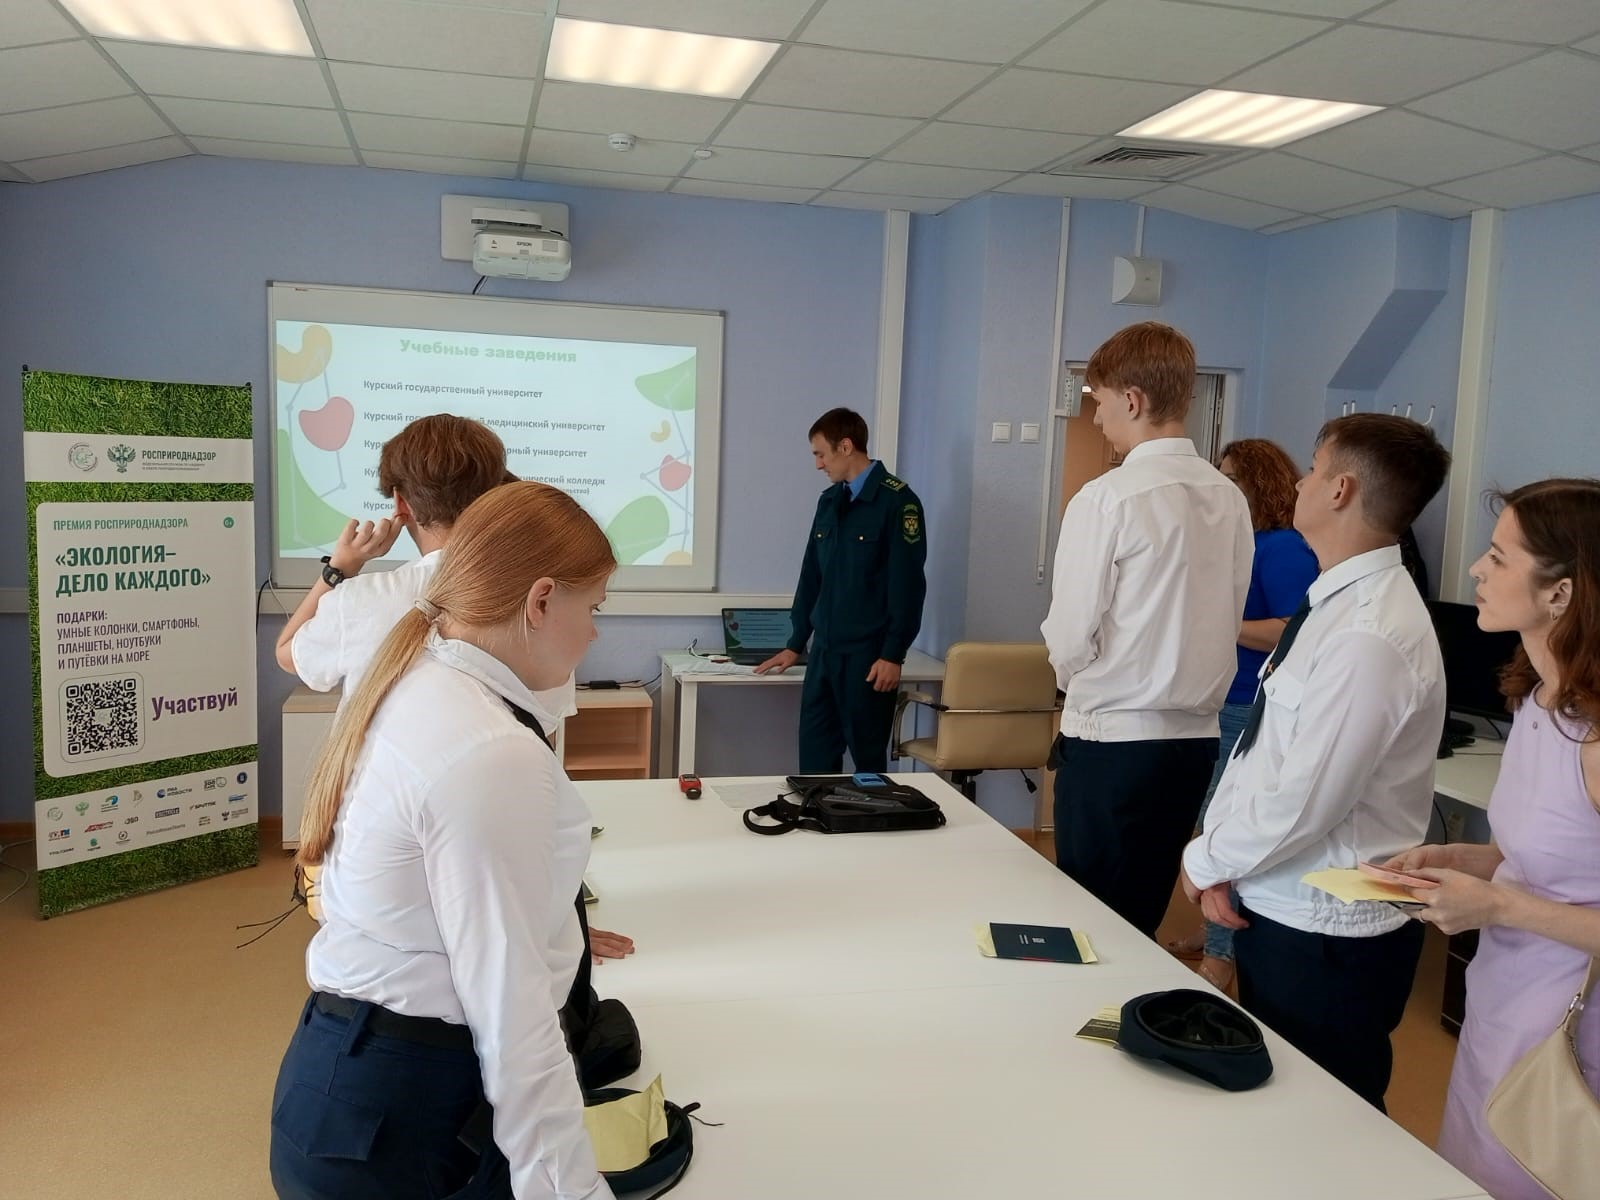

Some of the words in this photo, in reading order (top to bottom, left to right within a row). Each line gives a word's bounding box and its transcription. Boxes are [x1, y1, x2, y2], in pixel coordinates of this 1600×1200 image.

[399, 339, 480, 357] Учебные
[485, 347, 577, 363] заведения
[363, 380, 403, 391] Курский
[405, 384, 485, 395] государственный
[487, 387, 543, 398] университет
[363, 411, 403, 422] Курский
[487, 418, 550, 429] медицинский
[551, 421, 606, 432] университет
[142, 450, 217, 461] РОСПРИРОДНАДЗОР
[532, 448, 588, 458] университет
[566, 477, 605, 487] колледж
[53, 520, 92, 531] ПРЕМИЯ
[94, 518, 188, 530] РОСПРИРОДНАДЗОРА
[55, 572, 108, 598] ДЕЛО
[115, 568, 211, 592] КАЖДОГО»
[56, 610, 108, 624] ПОДАРКИ:
[57, 626, 92, 640] УМНЫЕ
[94, 622, 140, 636] КОЛОНКИ,
[142, 617, 200, 632] СМАРТФОНЫ,
[57, 640, 114, 655] ПЛАНШЕТЫ,
[116, 635, 162, 649] НОУТБУКИ
[58, 659, 65, 670] И
[67, 653, 109, 670] ПУТЁВКИ
[111, 653, 124, 665] НА
[126, 650, 151, 663] МОРЕ
[152, 687, 238, 721] Участвуй
